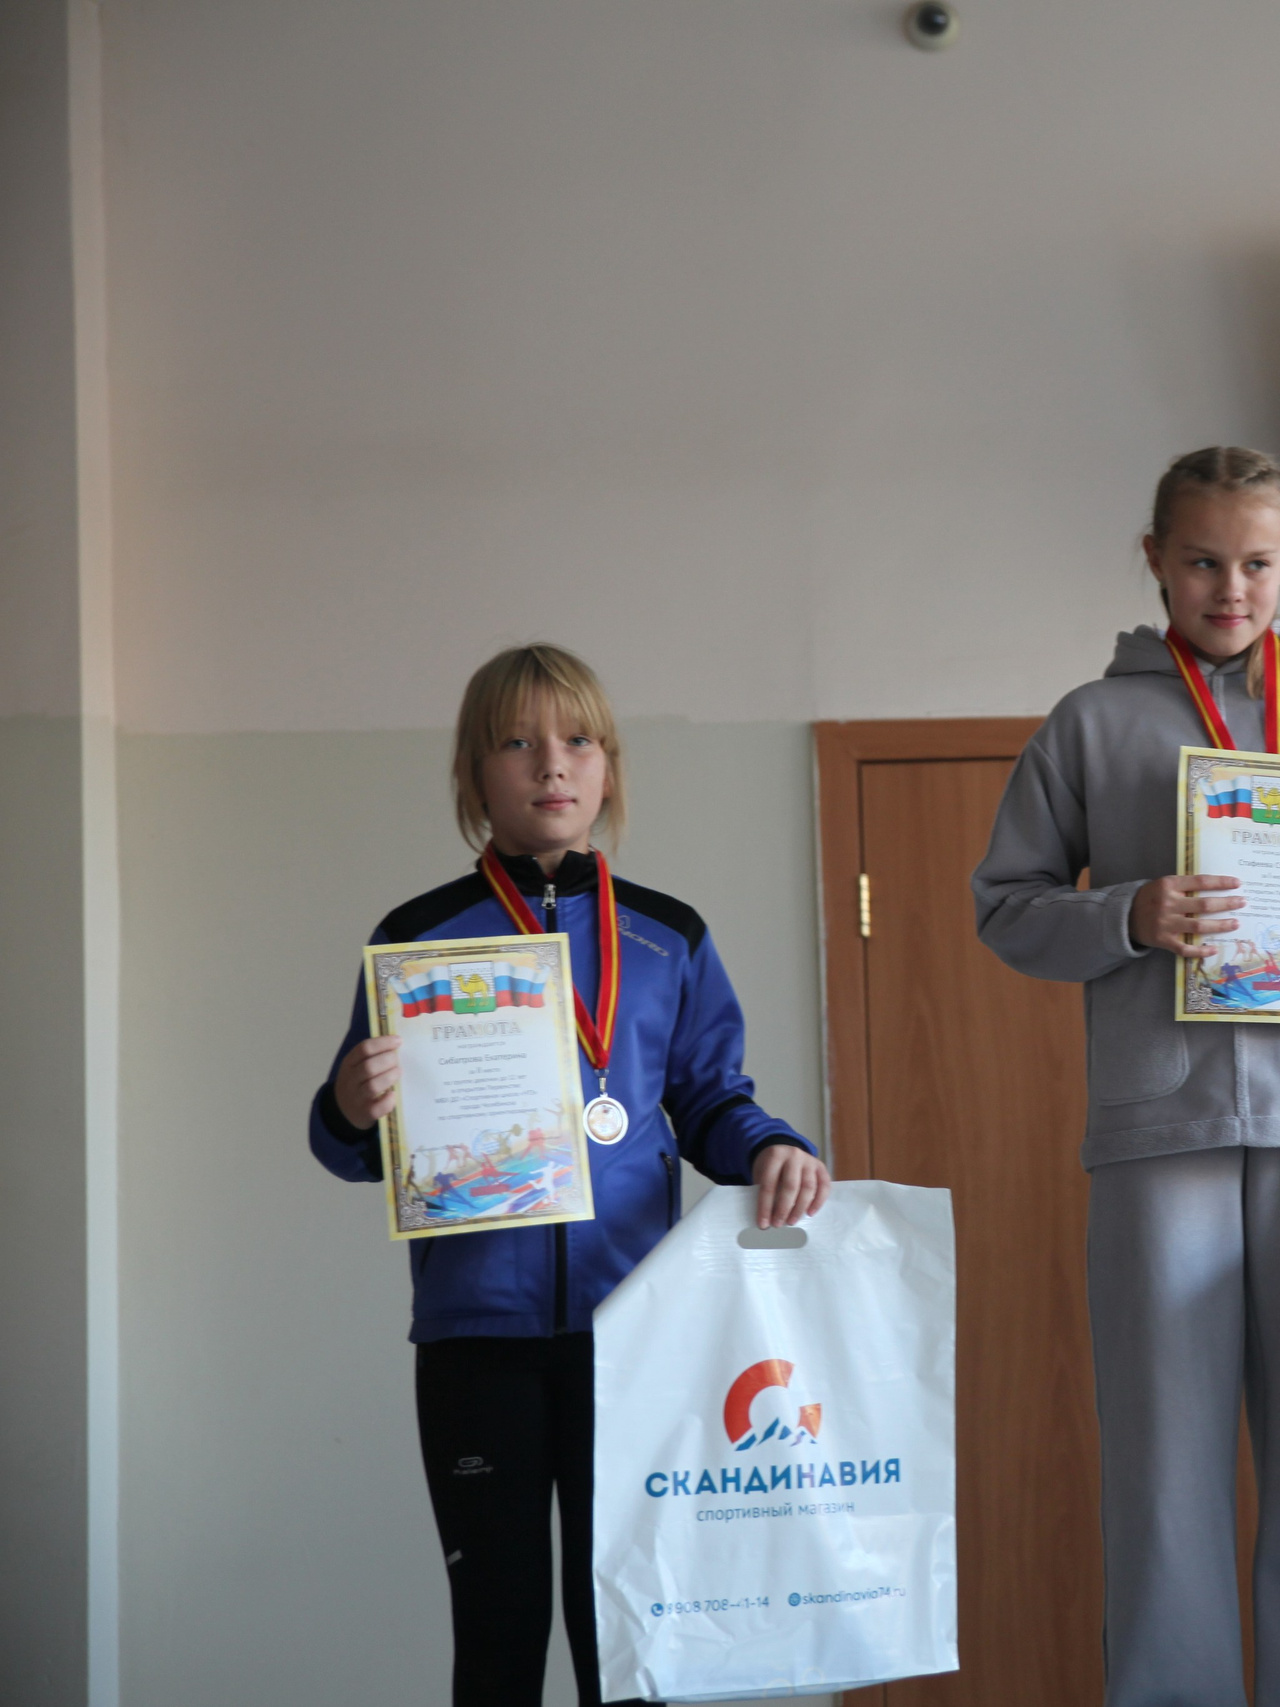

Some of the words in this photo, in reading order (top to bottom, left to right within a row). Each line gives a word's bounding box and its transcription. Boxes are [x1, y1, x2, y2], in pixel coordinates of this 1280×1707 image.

[432, 1020, 523, 1040] ГРАМОТА
[645, 1458, 900, 1498] СКАНДИНАВИЯ
[696, 1502, 793, 1523] спортивный
[797, 1501, 855, 1516] магазин
